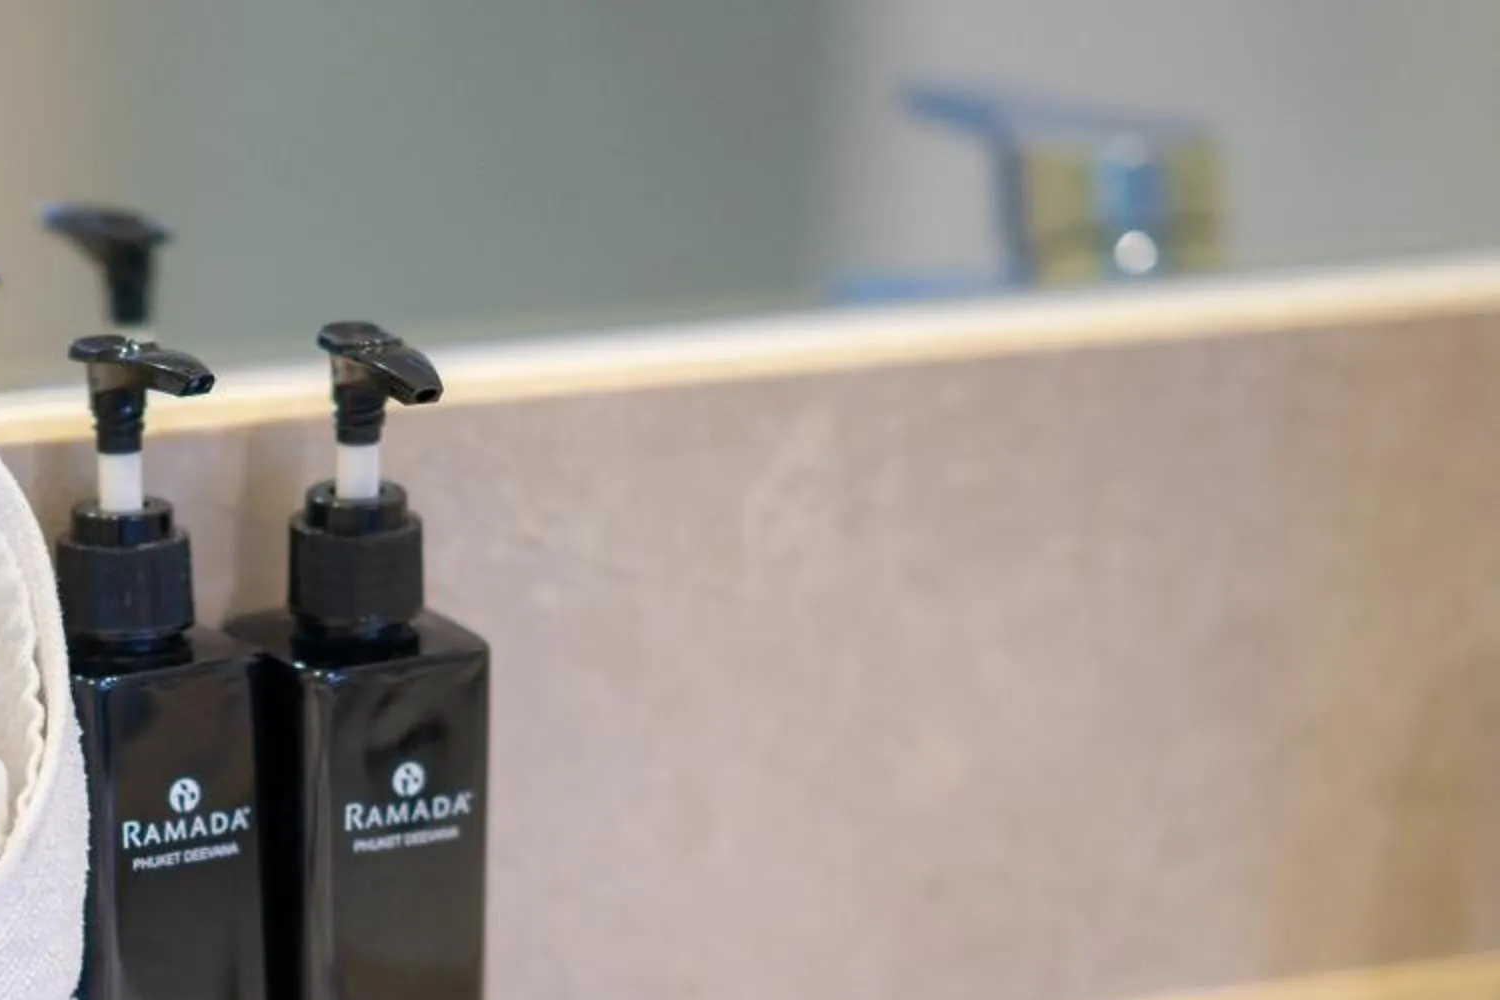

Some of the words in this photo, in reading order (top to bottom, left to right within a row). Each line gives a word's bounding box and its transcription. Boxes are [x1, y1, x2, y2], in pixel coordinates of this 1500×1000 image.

[122, 806, 250, 849] RAMADA
[344, 792, 471, 831] RAMADA
[132, 851, 181, 871] PHUKET
[184, 842, 239, 862] DEEVANA
